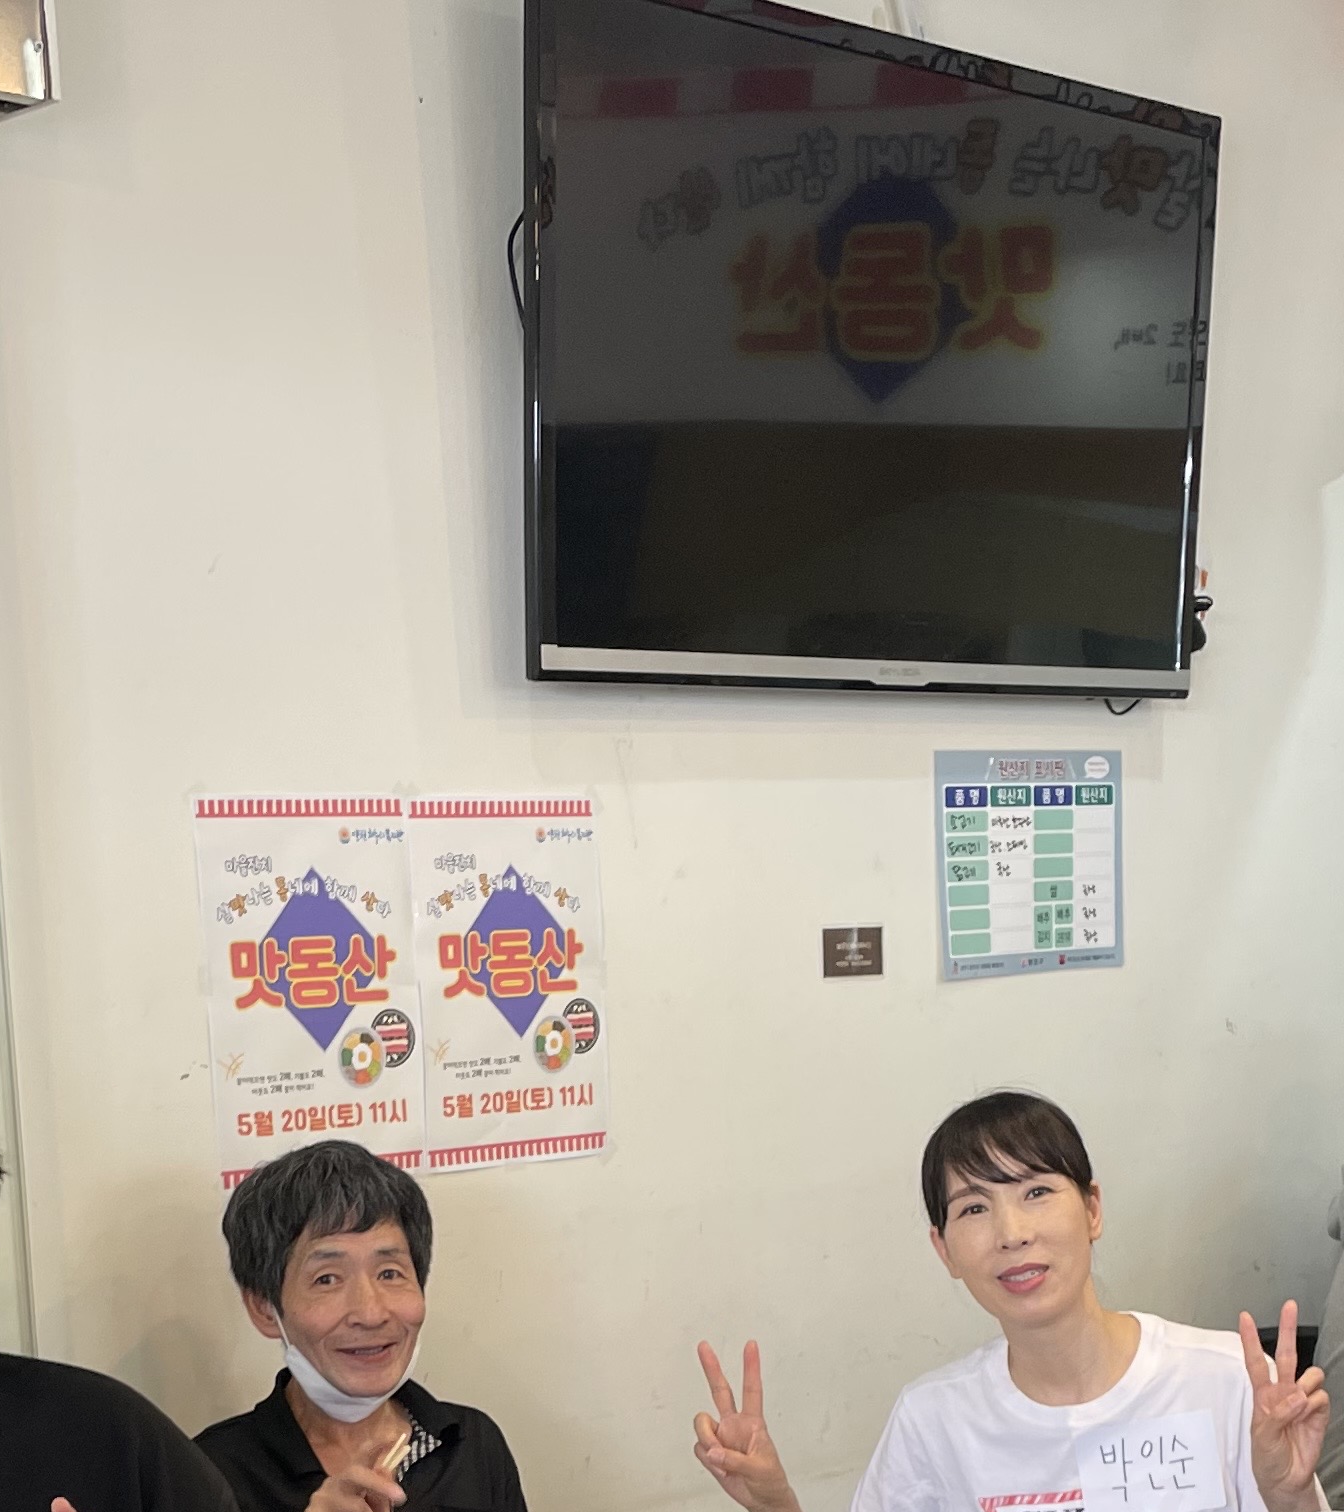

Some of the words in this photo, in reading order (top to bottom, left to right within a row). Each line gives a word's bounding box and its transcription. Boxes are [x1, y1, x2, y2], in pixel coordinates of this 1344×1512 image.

[228, 933, 398, 1011] 맛동산
[438, 928, 585, 998] 맛동산
[237, 1110, 274, 1137] 5월
[281, 1102, 363, 1133] 20일(토)
[369, 1098, 407, 1123] 11시
[443, 1093, 473, 1118] 5월
[480, 1086, 554, 1114] 20일(토)
[559, 1082, 593, 1106] 11시
[1099, 1434, 1196, 1503] 박인순
